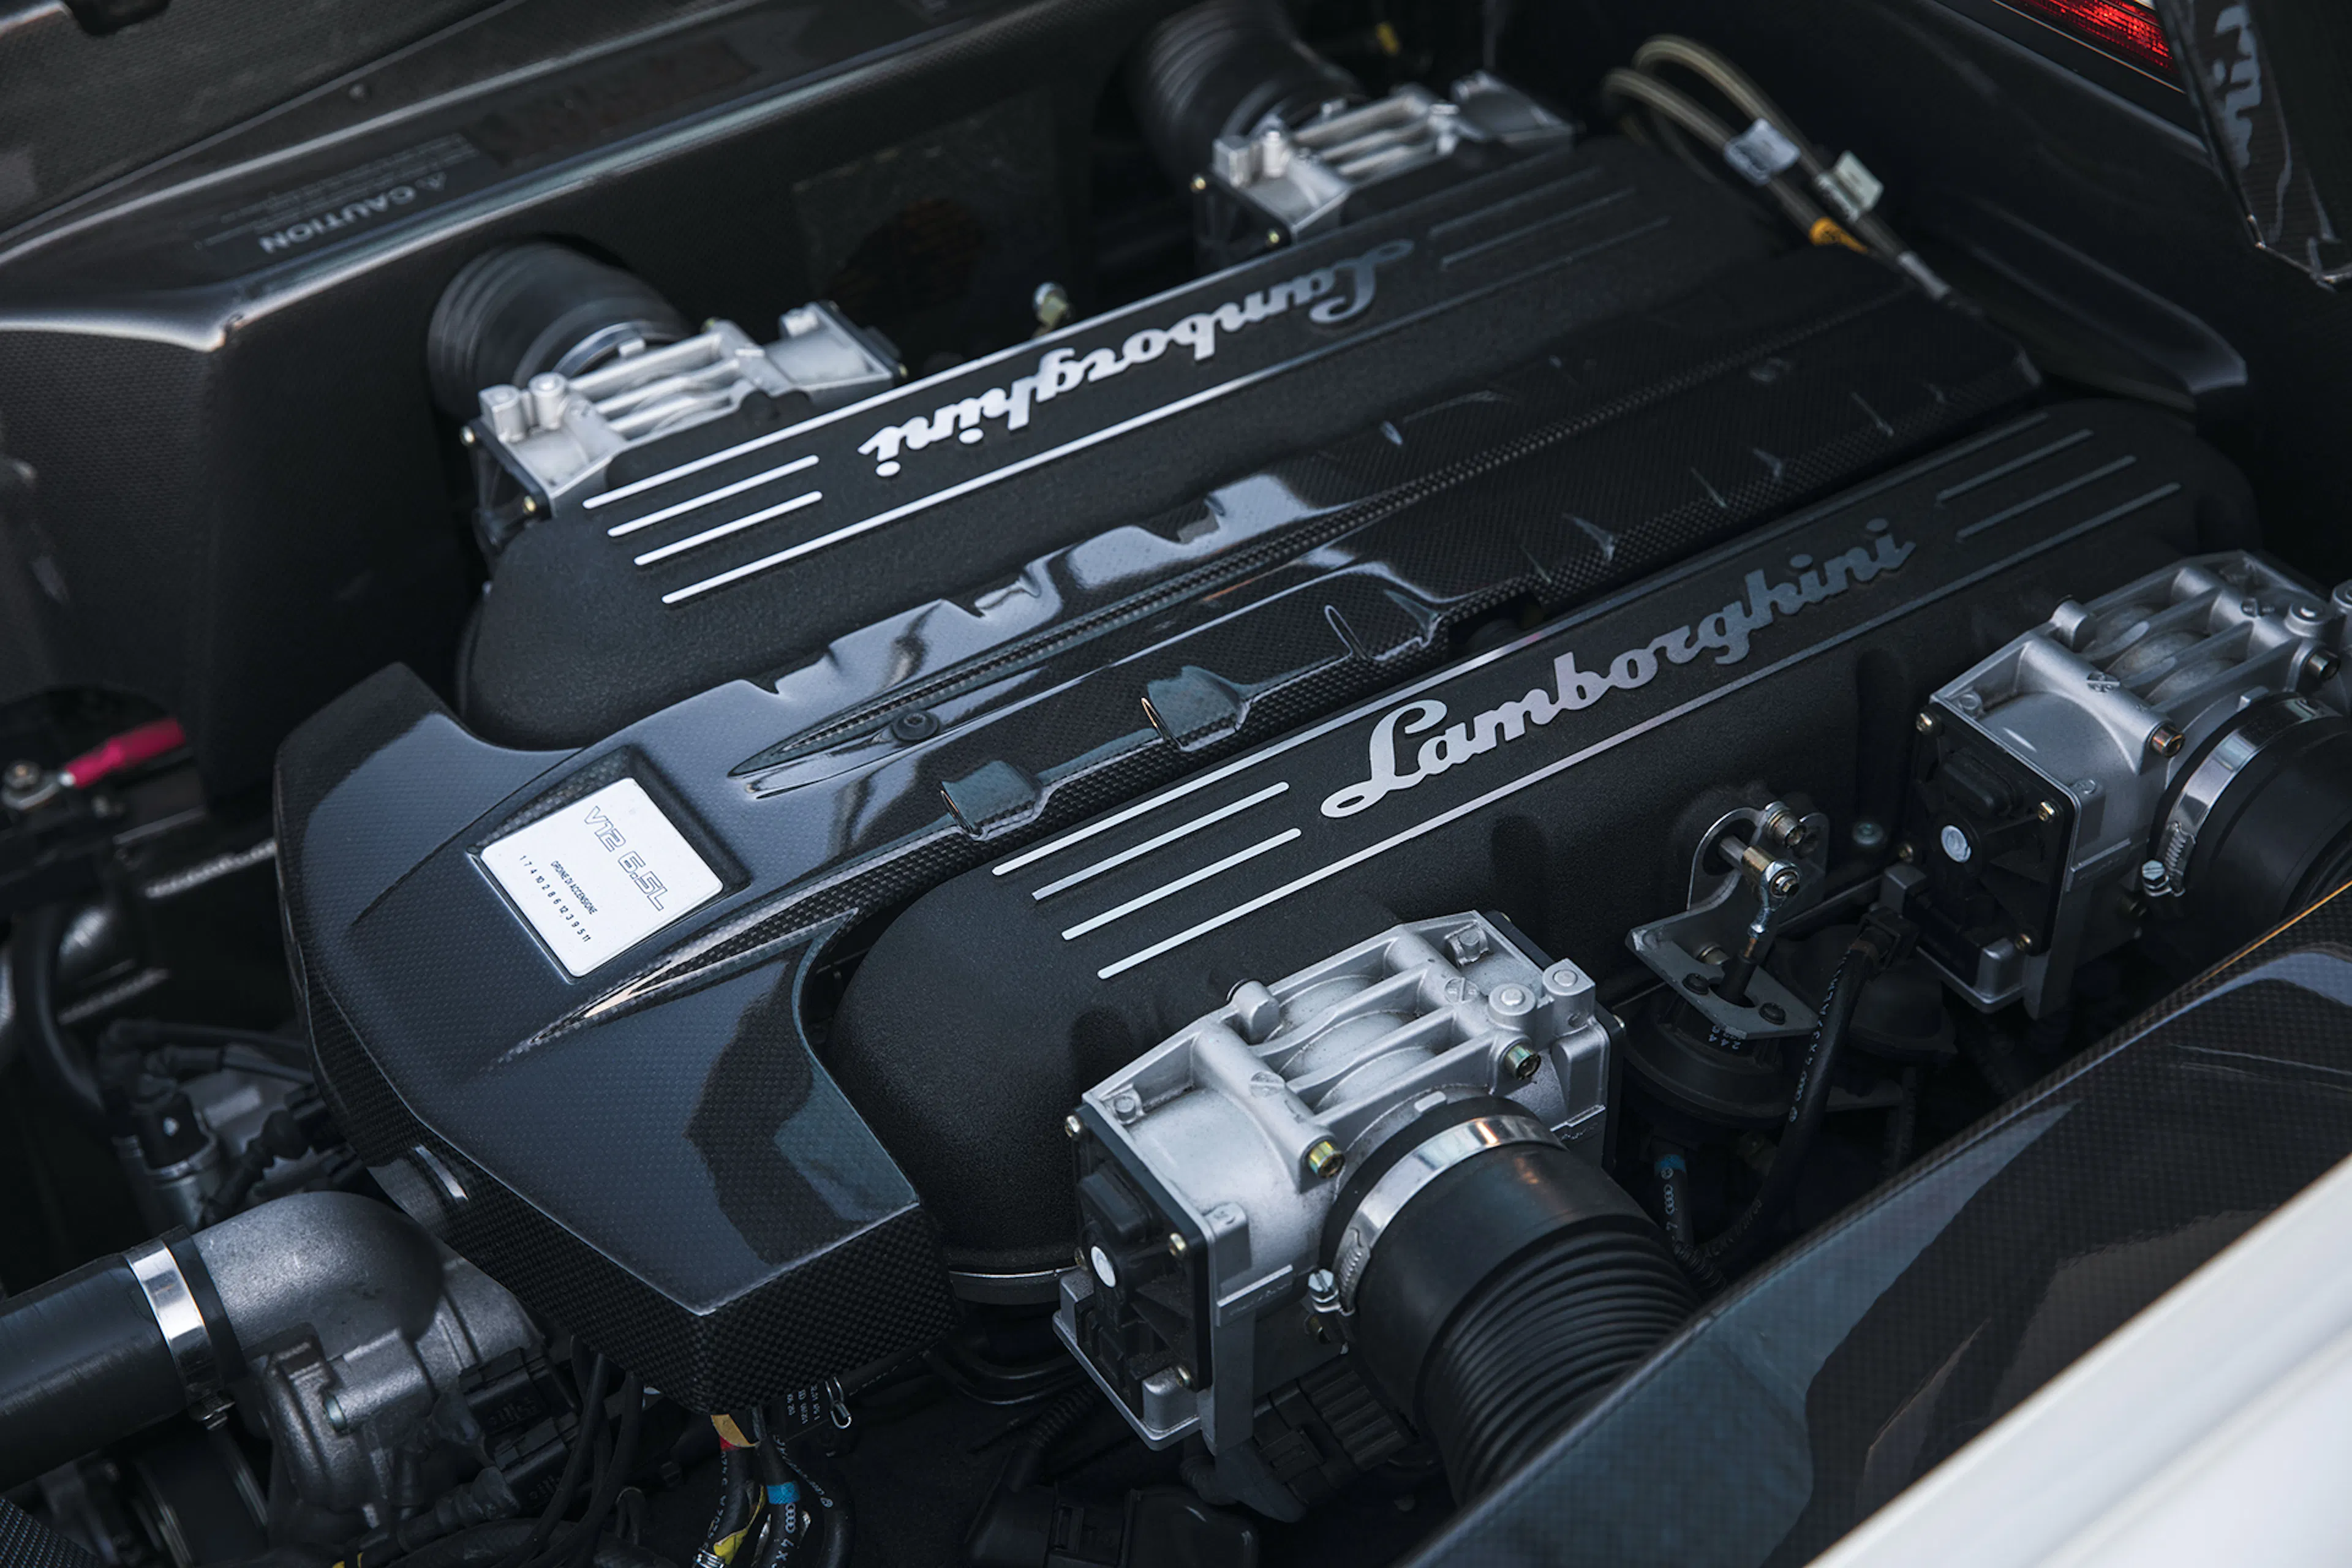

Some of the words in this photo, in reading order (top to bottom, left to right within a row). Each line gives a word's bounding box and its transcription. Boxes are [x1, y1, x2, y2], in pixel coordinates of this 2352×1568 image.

[258, 185, 416, 254] CAUTION
[856, 238, 1414, 478] Lamborghini
[1320, 517, 1917, 819] Lamborghini
[536, 875, 545, 884] 10
[559, 905, 569, 914] 12
[550, 860, 570, 880] ORDINE
[564, 877, 574, 886] DI
[569, 883, 598, 915] ACCENSIONE
[584, 805, 627, 852] V12
[617, 851, 668, 911] 6.5L
